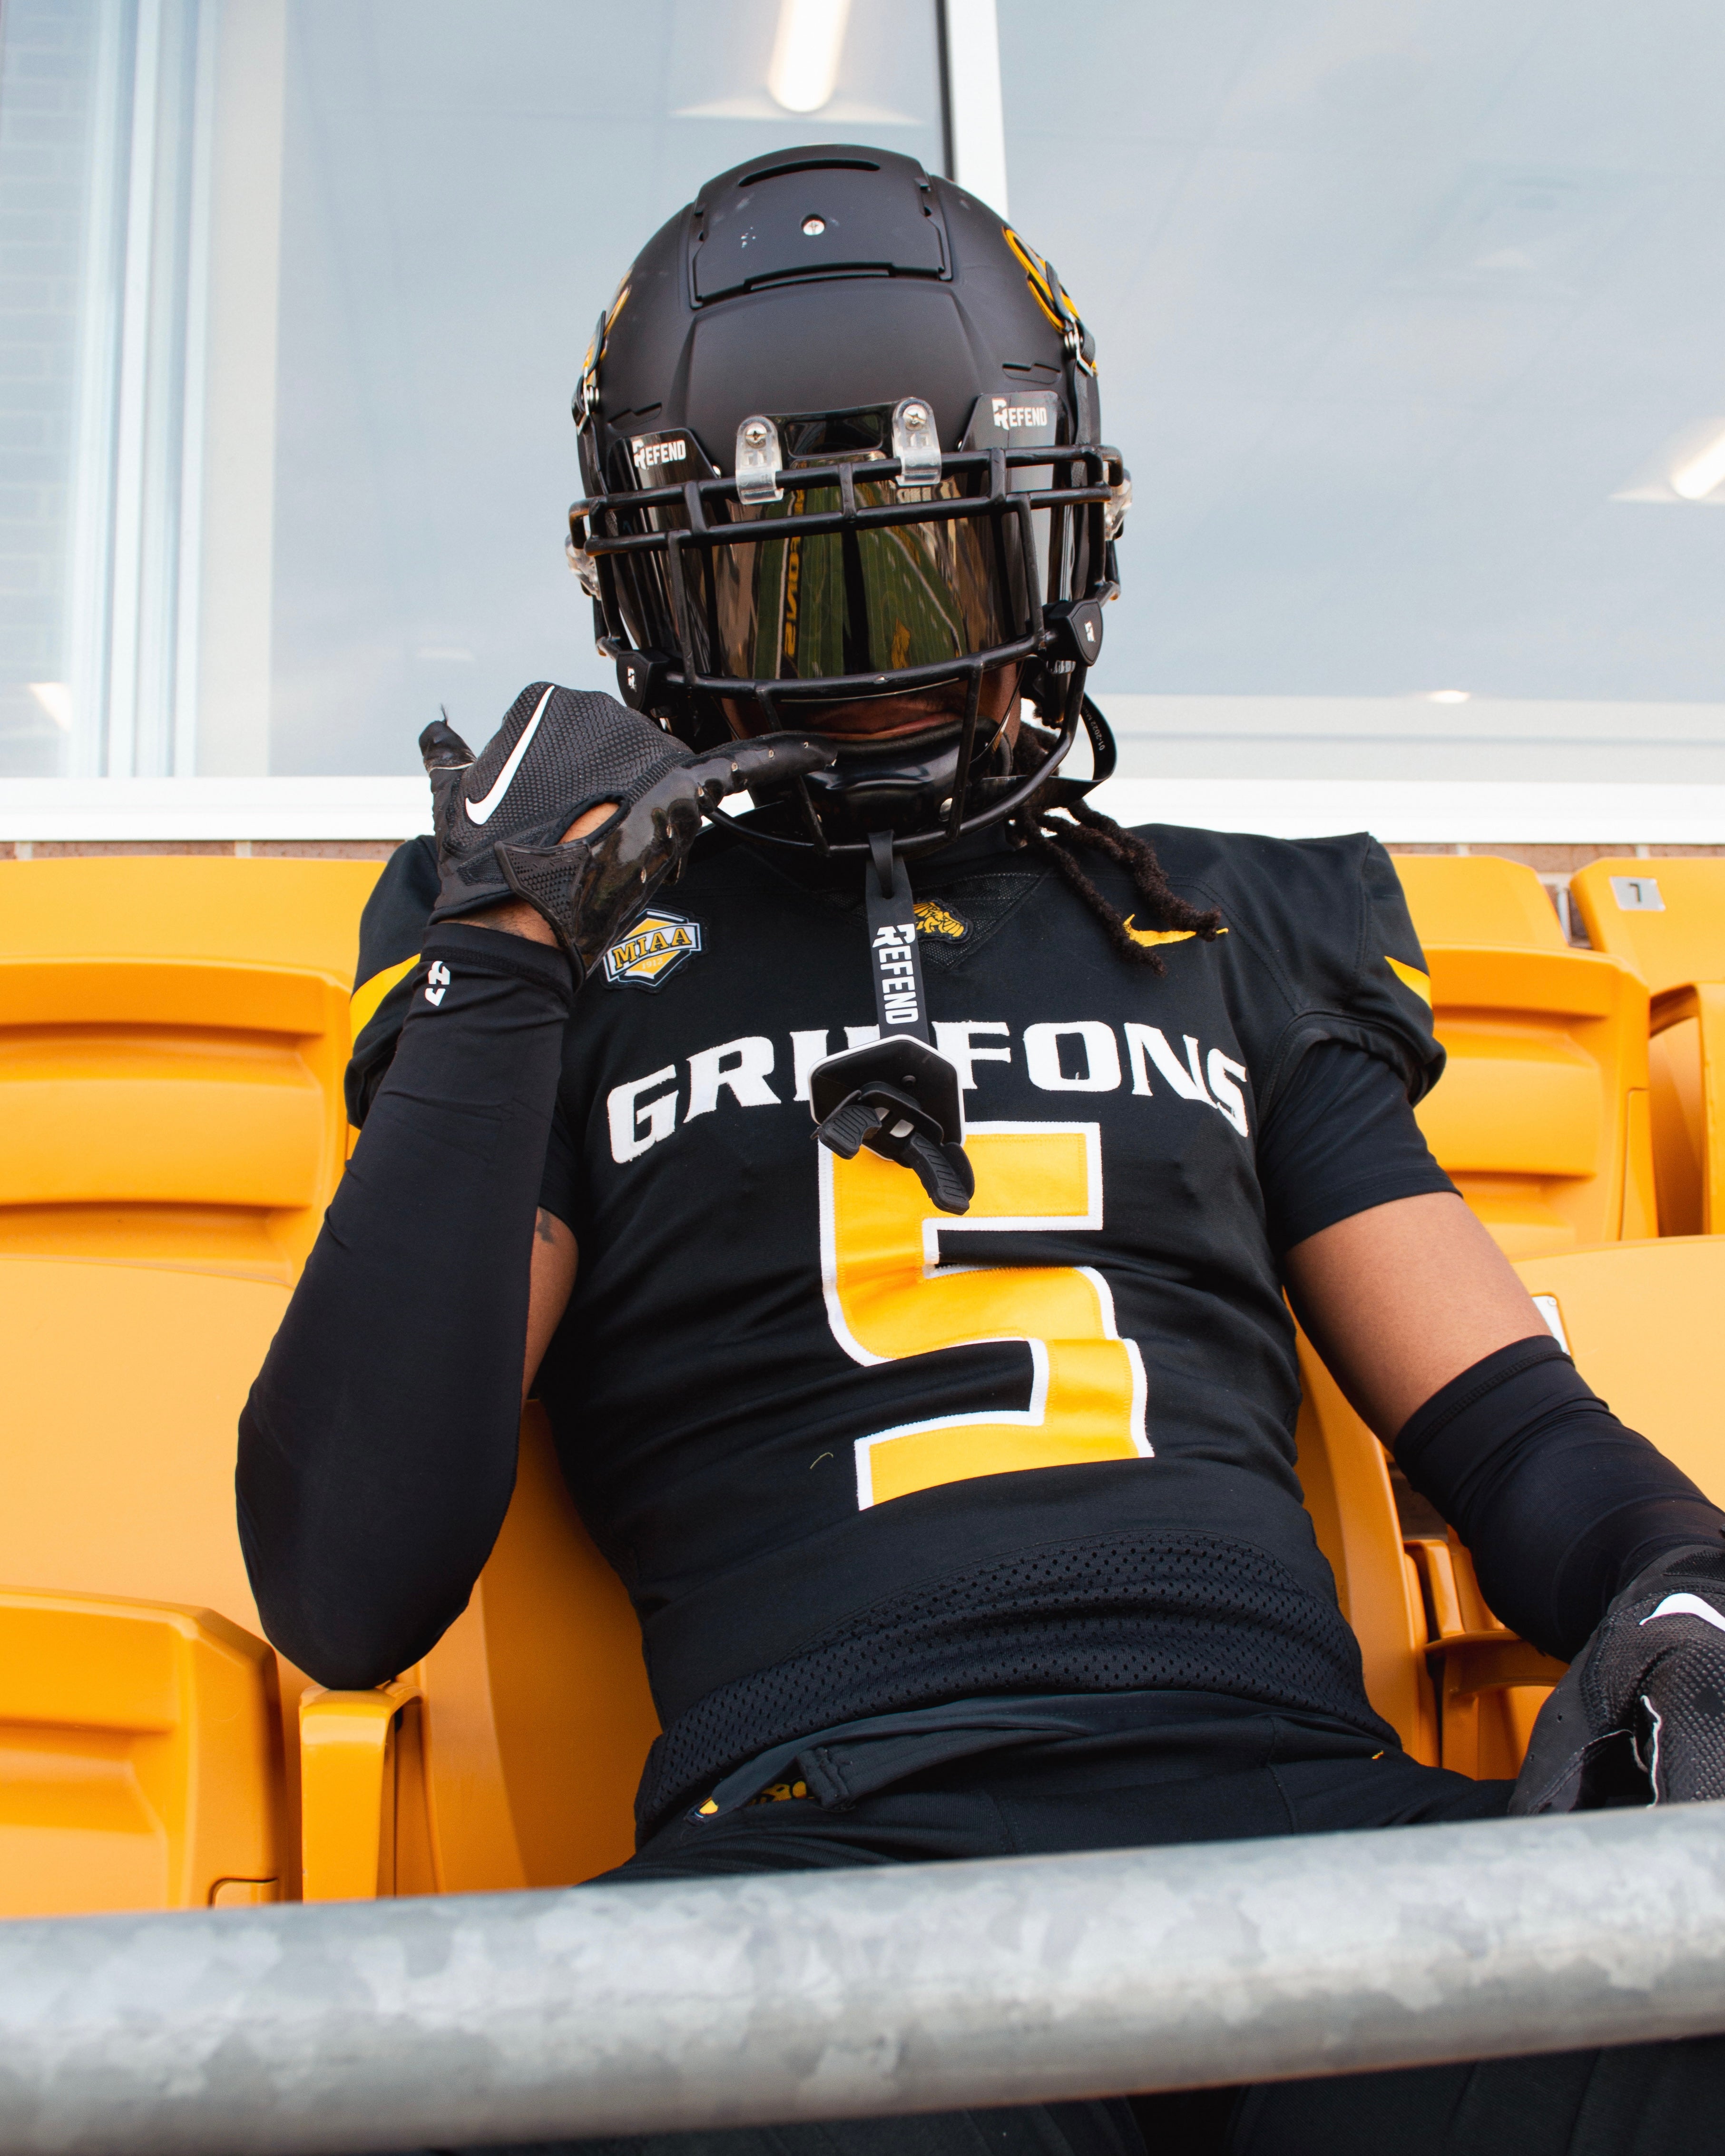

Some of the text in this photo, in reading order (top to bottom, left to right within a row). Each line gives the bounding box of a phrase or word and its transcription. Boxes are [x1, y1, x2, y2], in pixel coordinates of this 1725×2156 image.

[992, 398, 1047, 430] REFEND
[632, 439, 686, 470] REFEND
[1628, 883, 1642, 903] 7
[612, 928, 692, 971] MIAA
[642, 957, 663, 970] 1912
[872, 923, 919, 1025] REFEND
[607, 1020, 1249, 1164] GRIFONS
[818, 1121, 1155, 1511] 5
